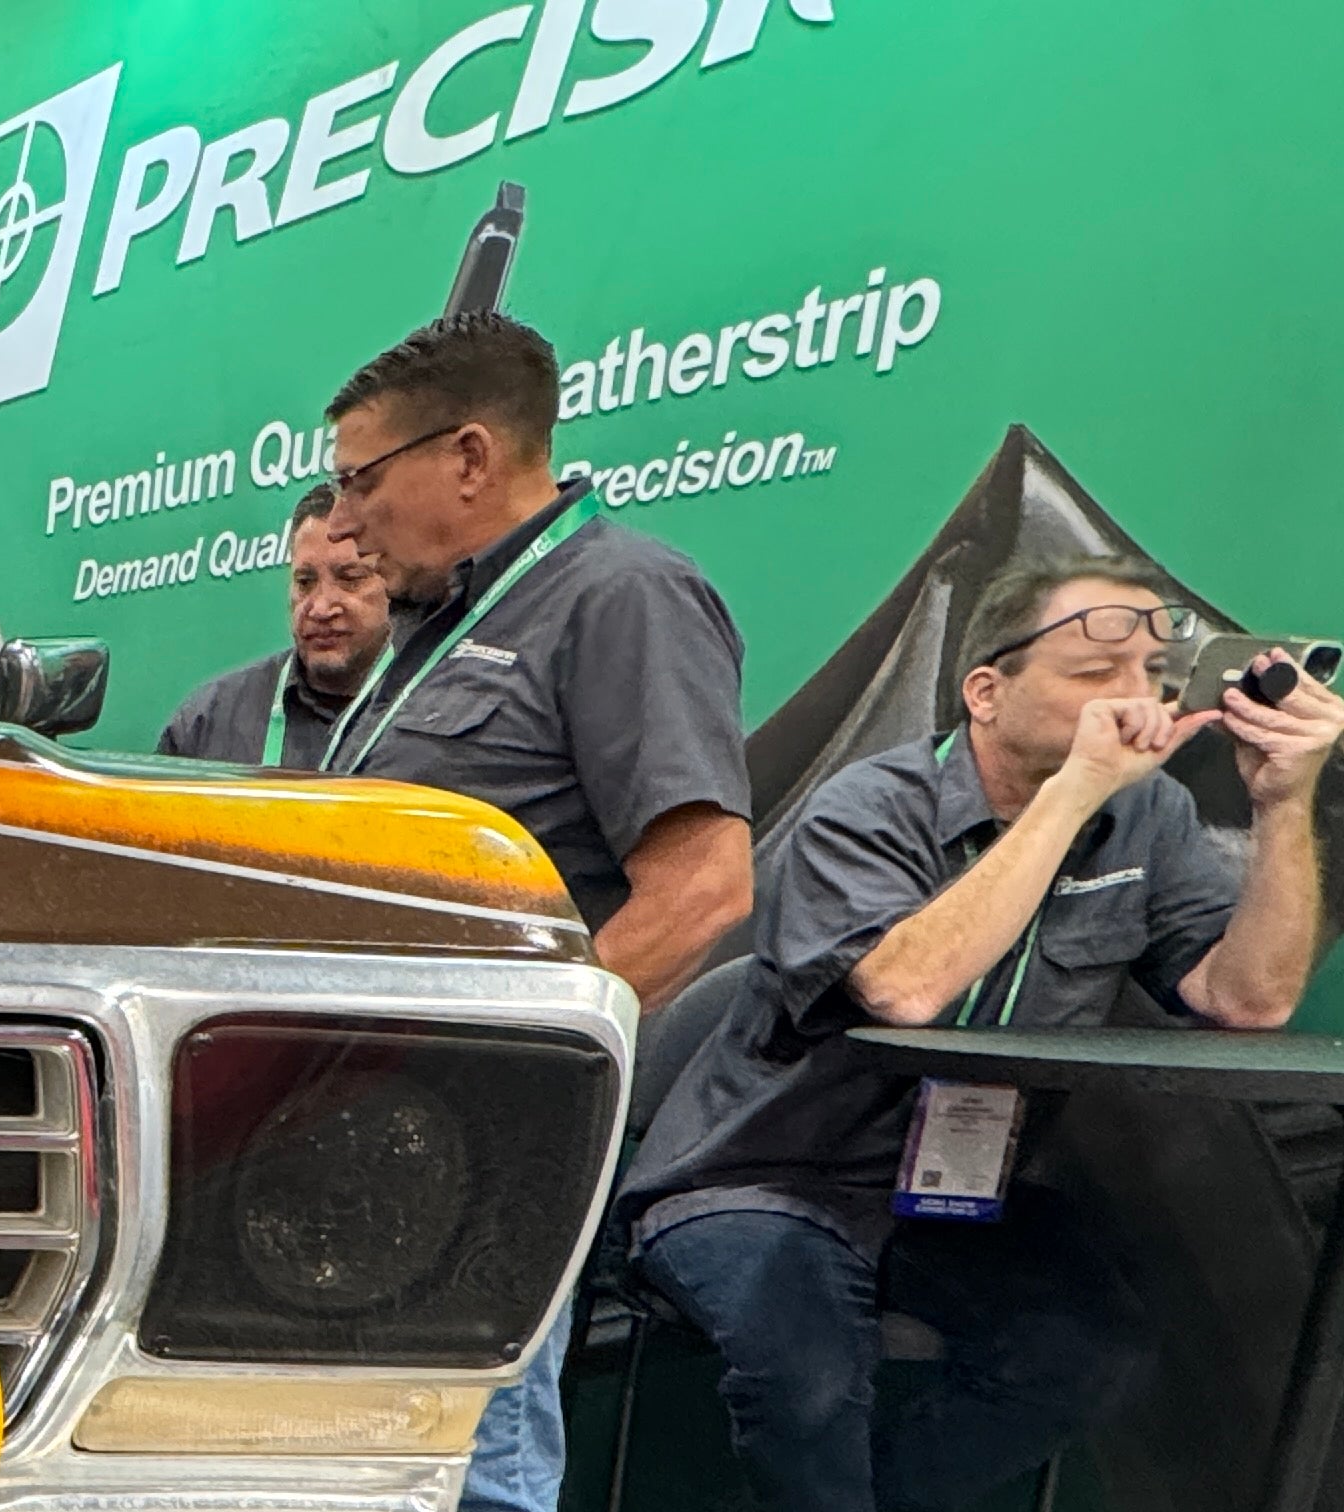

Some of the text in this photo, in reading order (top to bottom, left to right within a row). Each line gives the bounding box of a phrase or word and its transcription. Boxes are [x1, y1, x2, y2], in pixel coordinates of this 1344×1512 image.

[92, 0, 835, 298] PRECIS
[46, 448, 236, 535] Premium
[73, 537, 204, 601] Demand
